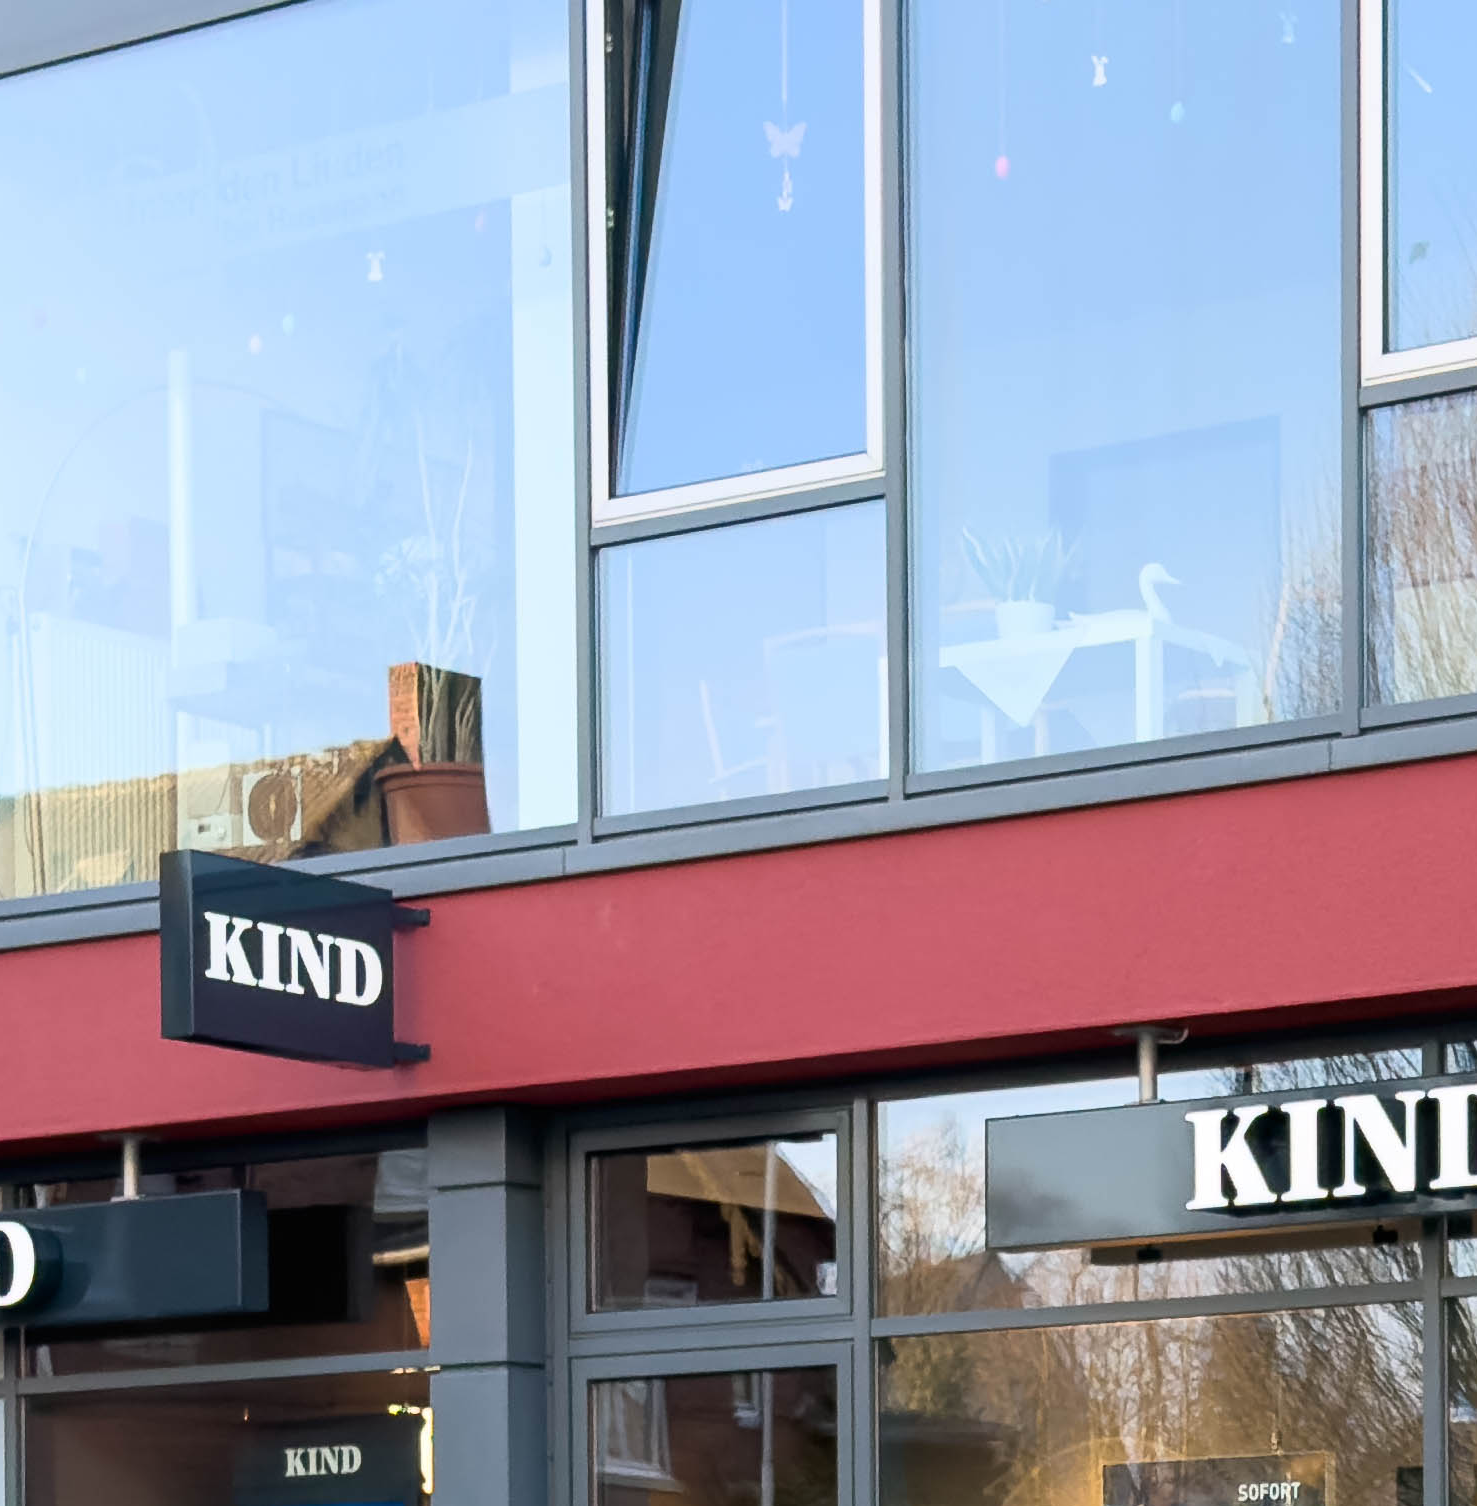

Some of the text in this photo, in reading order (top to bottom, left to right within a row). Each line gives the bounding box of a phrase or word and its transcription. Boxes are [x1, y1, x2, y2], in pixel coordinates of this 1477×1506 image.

[203, 911, 383, 1007] KIND
[284, 1445, 363, 1478] KIND
[1237, 1481, 1301, 1504] SOFORT
